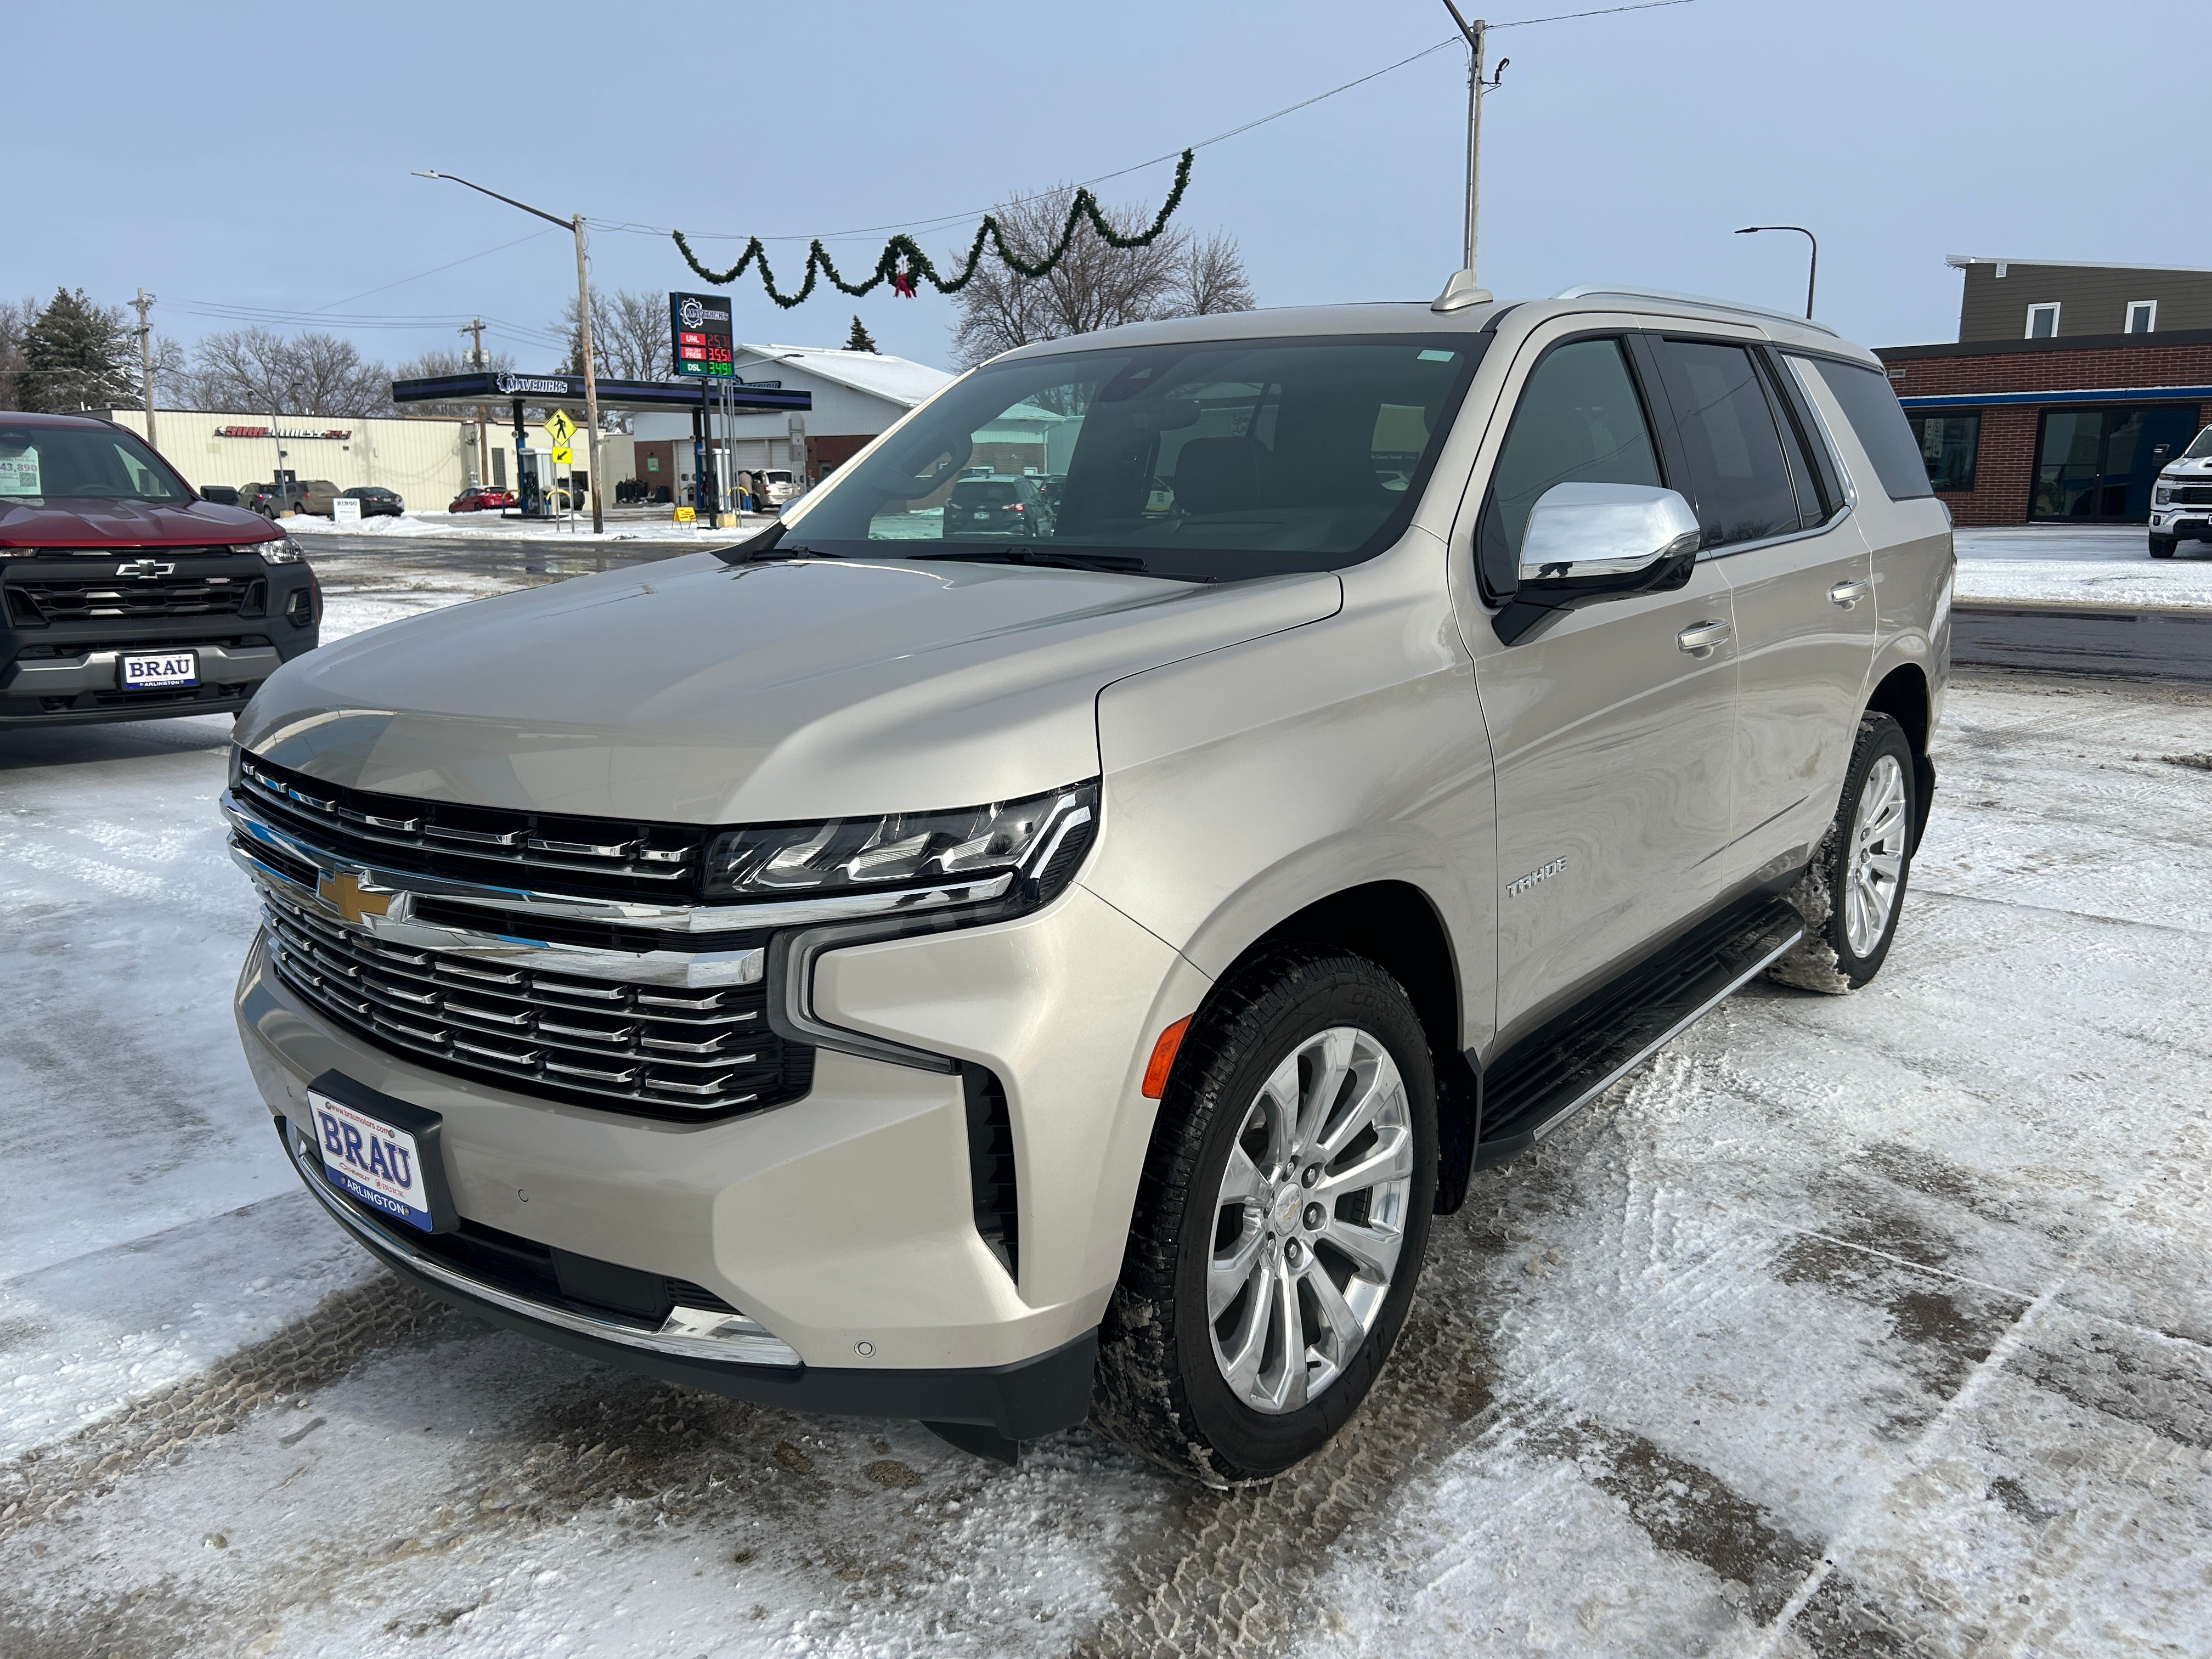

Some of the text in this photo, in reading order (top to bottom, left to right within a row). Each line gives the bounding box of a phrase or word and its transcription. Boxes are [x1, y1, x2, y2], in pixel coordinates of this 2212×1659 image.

[686, 335, 700, 343] UNL
[687, 363, 701, 371] DSL
[225, 426, 269, 437] SNAP
[128, 659, 190, 678] BRAU
[1505, 855, 1567, 899] TAHOE
[317, 1108, 412, 1190] BRAU
[347, 1178, 405, 1216] ARLINGTON
[382, 1183, 405, 1198] BUICK
